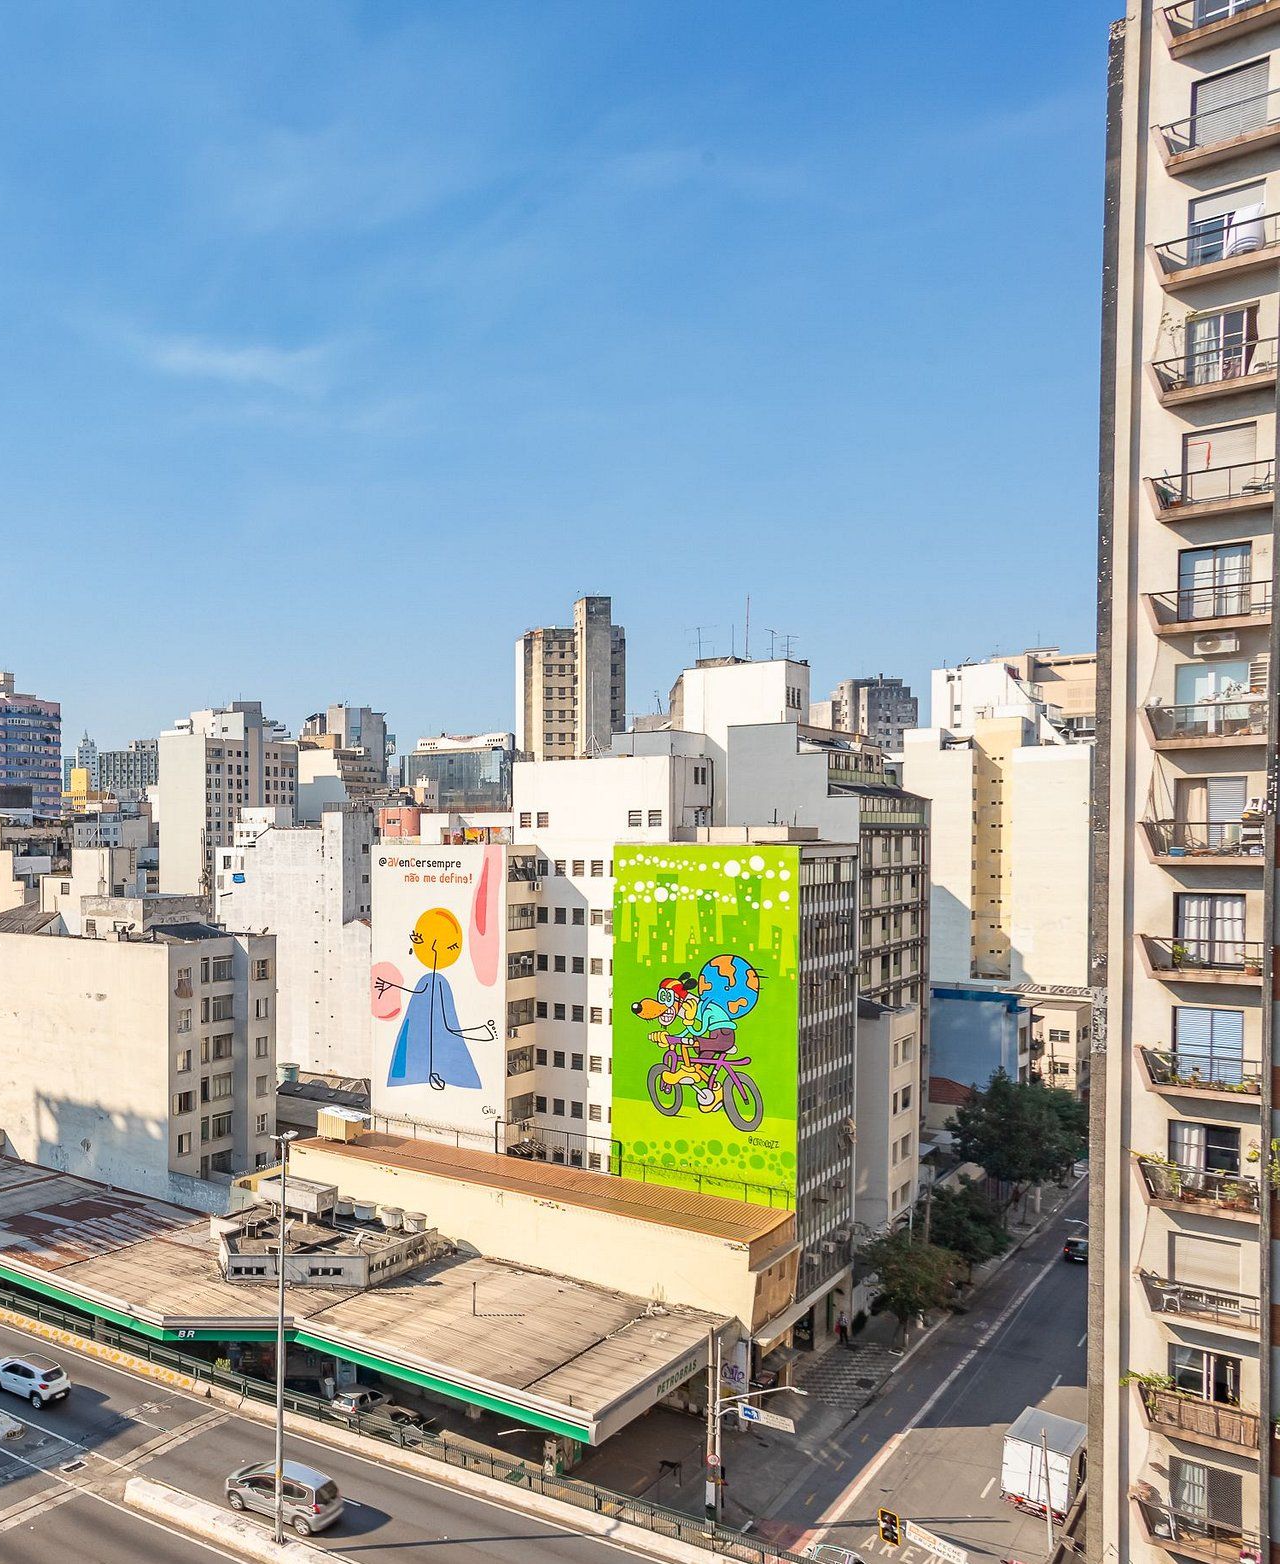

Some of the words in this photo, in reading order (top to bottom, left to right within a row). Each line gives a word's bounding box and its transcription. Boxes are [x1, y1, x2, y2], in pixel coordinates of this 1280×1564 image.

[404, 872, 420, 883] não
[423, 874, 437, 883] me
[178, 1330, 196, 1338] BR
[656, 1358, 697, 1397] PETROBRAS
